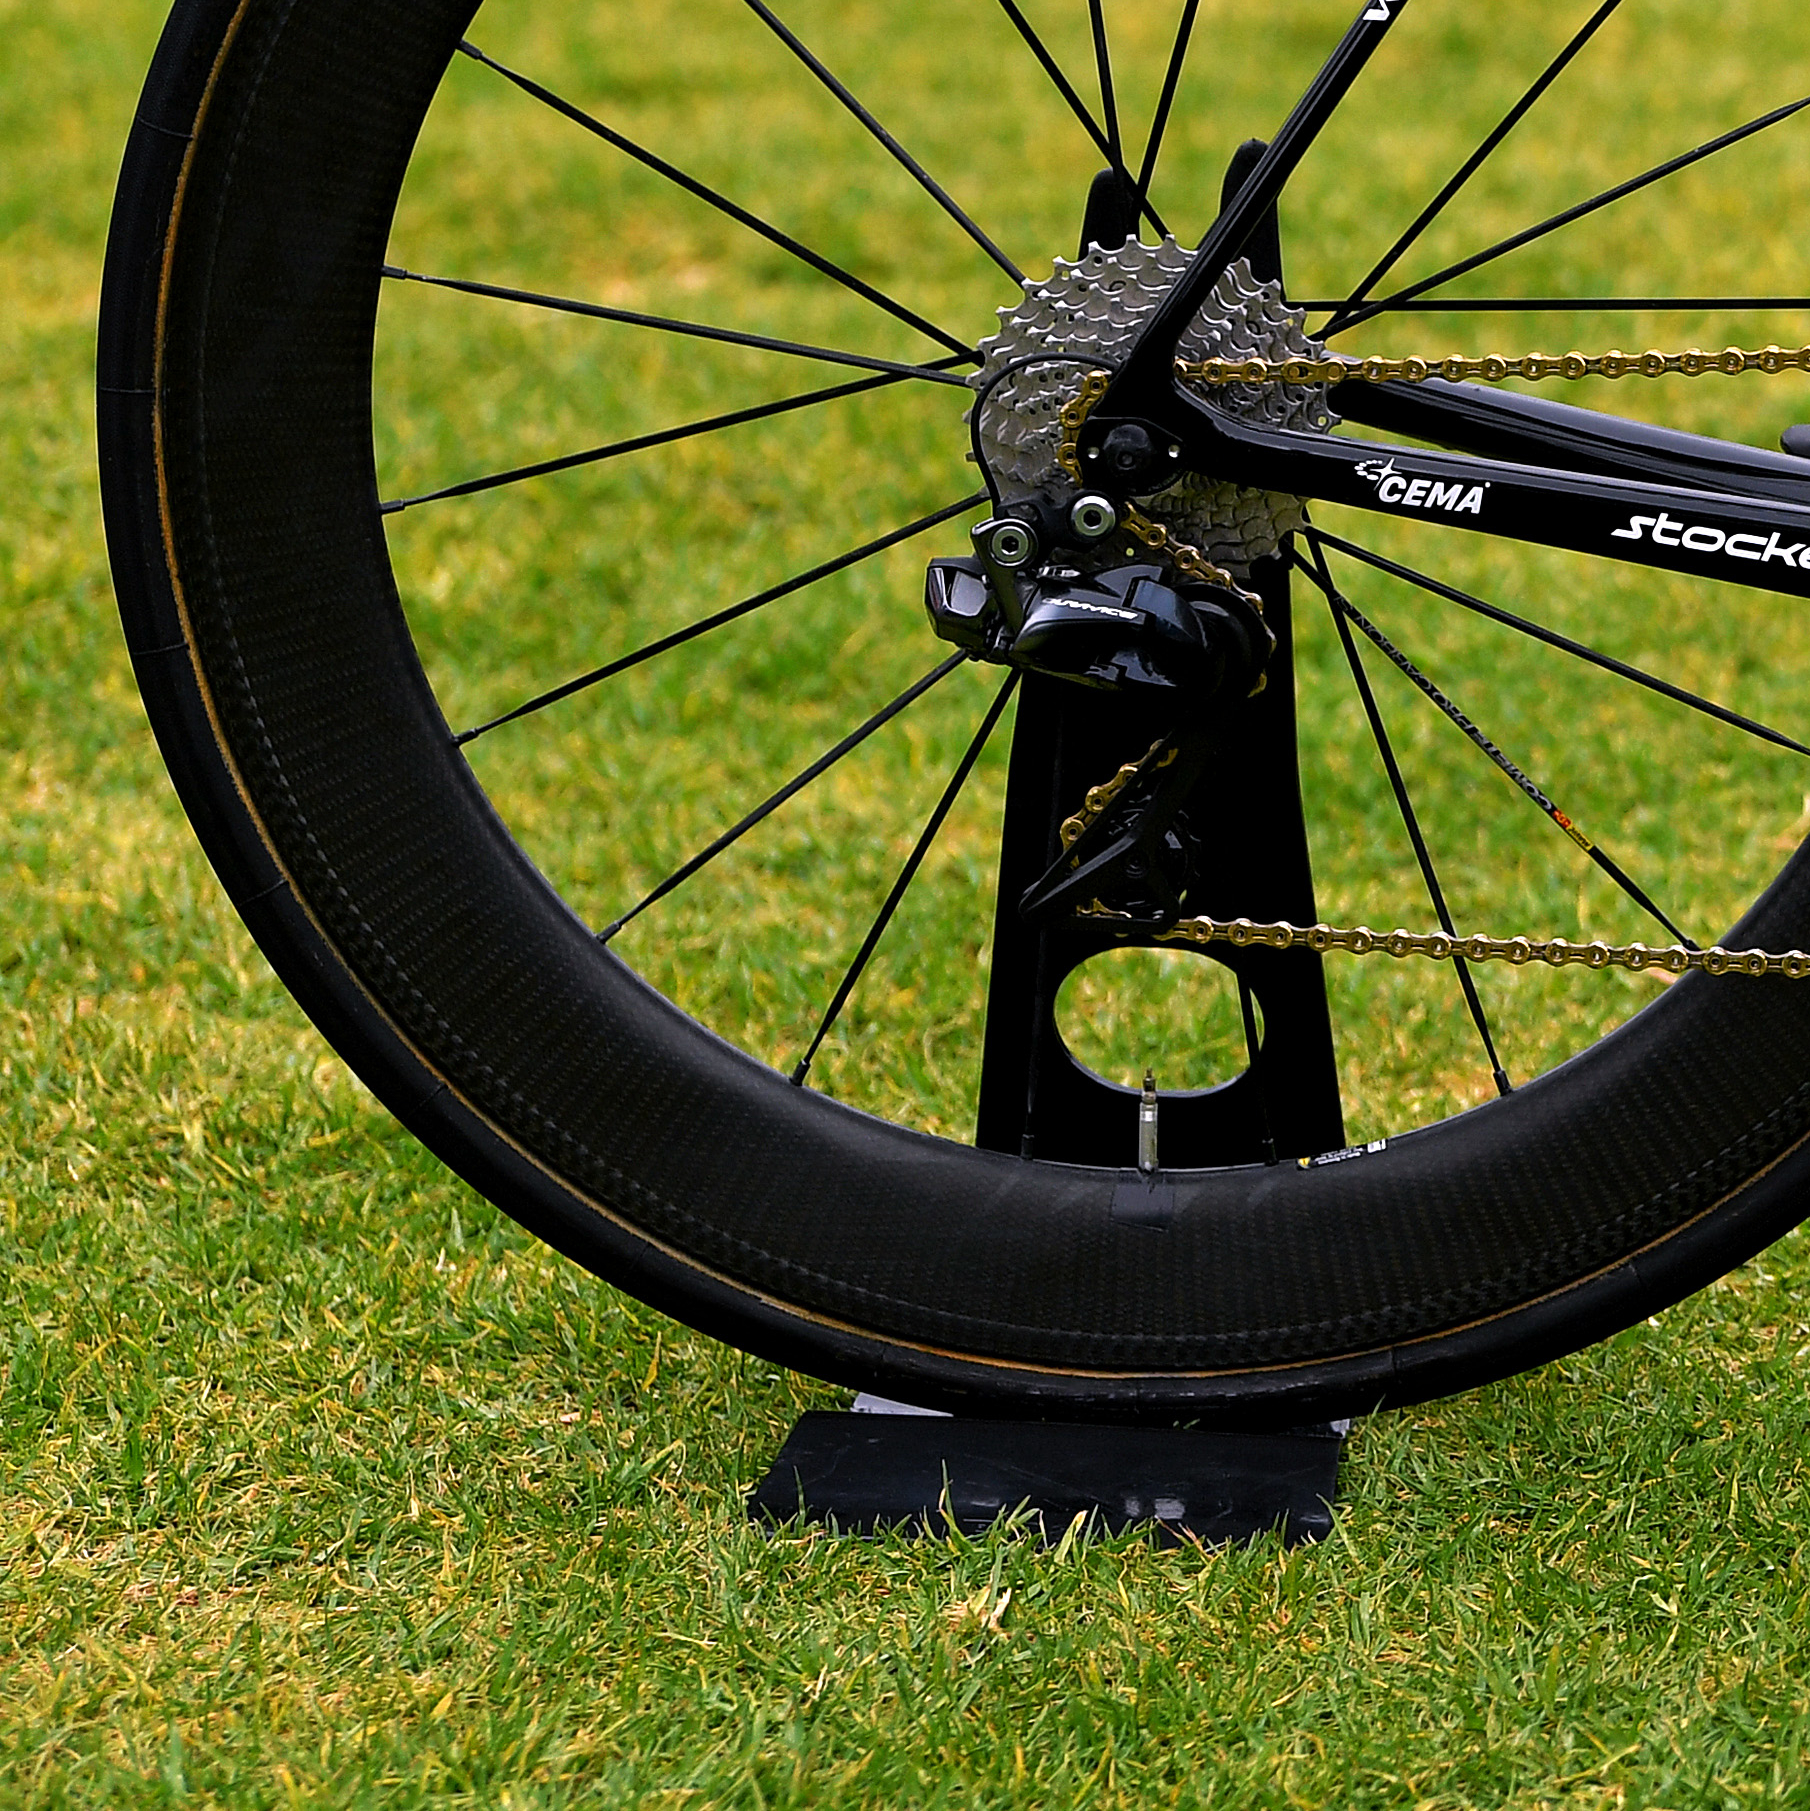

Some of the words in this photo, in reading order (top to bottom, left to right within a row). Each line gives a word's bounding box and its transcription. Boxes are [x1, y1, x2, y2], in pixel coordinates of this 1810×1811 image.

[1378, 476, 1484, 514] CEMA
[1355, 615, 1432, 690] CARBON
[1432, 691, 1475, 731] PRO
